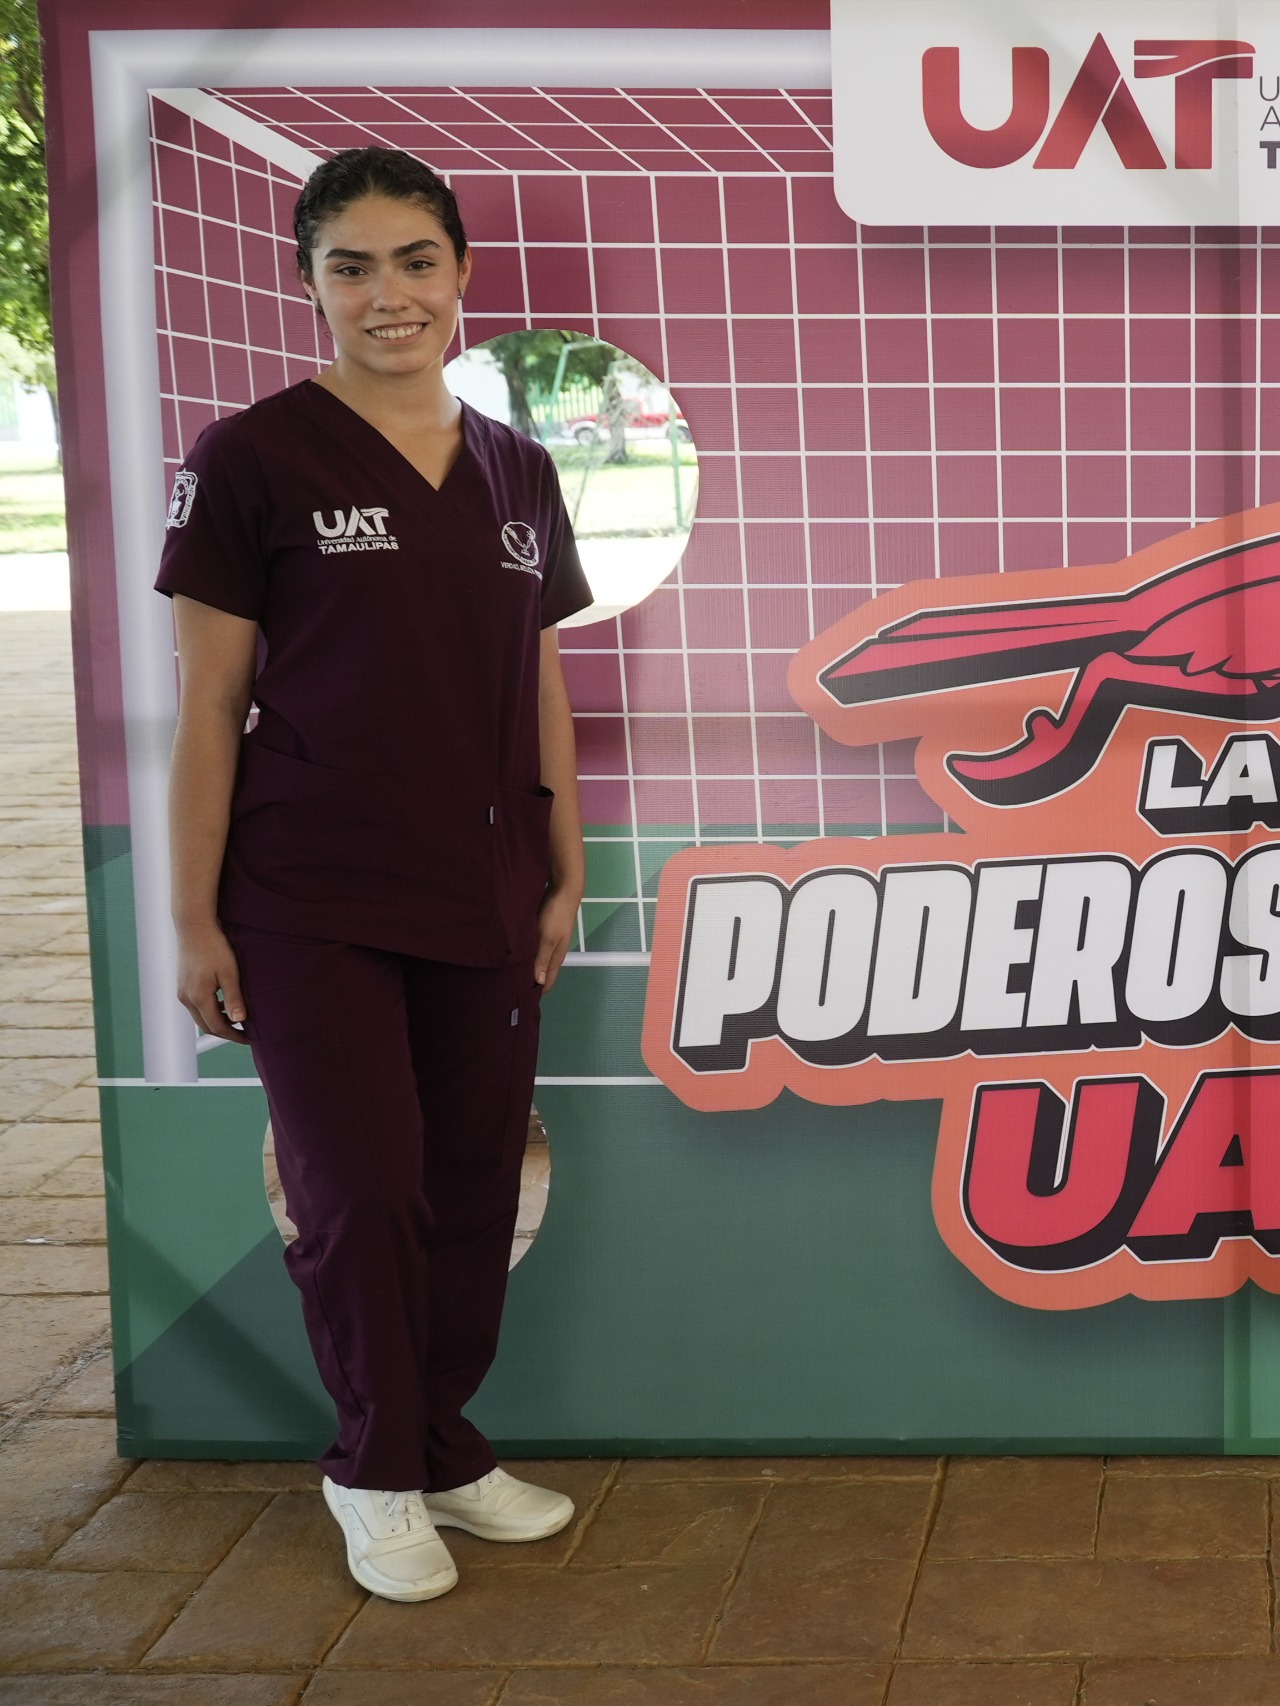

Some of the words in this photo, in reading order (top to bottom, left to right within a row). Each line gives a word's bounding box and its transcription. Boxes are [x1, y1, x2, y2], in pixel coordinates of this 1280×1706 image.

[921, 32, 1257, 170] UAT
[312, 505, 389, 538] UAT
[317, 536, 355, 546] Universidad
[318, 541, 399, 555] TAMAULIPAS
